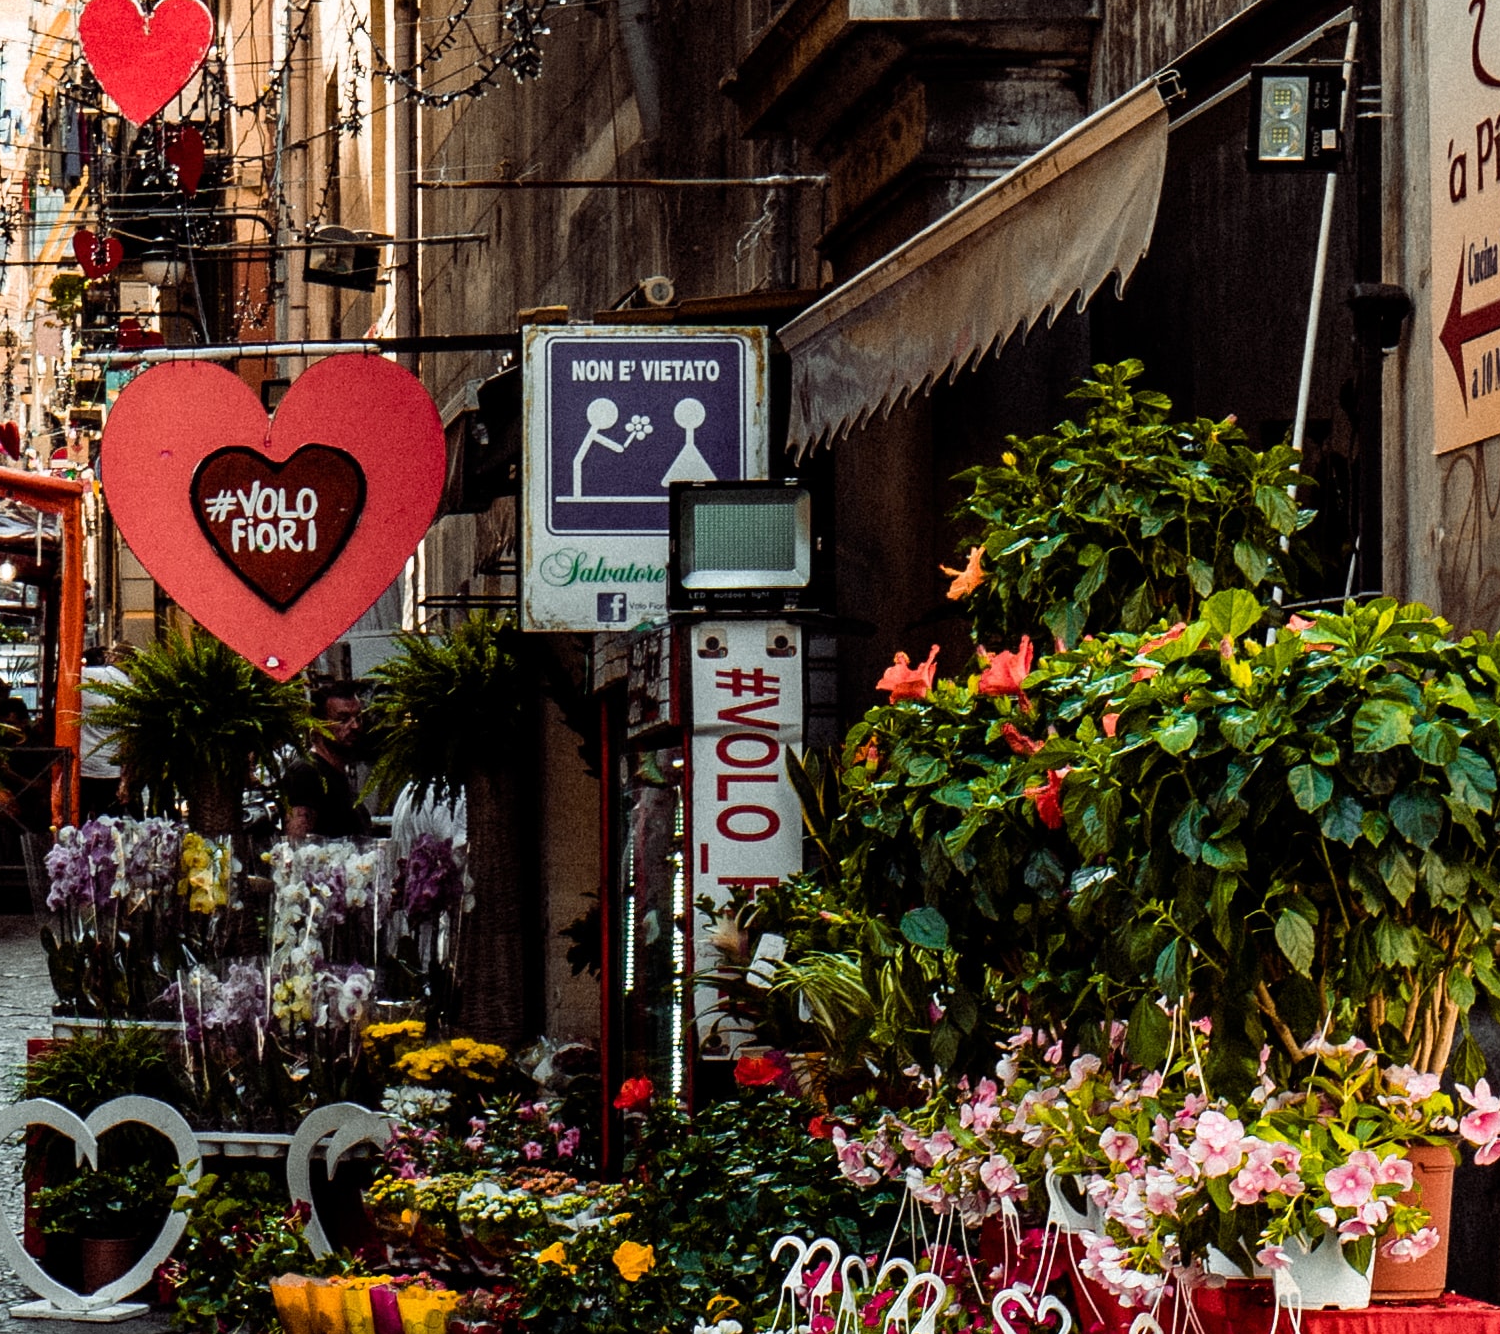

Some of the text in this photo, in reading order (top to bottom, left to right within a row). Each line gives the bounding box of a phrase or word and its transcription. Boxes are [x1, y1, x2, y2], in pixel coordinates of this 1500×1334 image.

[1467, 236, 1498, 286] Cucina
[571, 360, 613, 382] NON
[641, 359, 720, 382] VIETATO
[1482, 351, 1493, 397] 10
[204, 480, 318, 522] #VOLO
[540, 547, 667, 587] Salvatore
